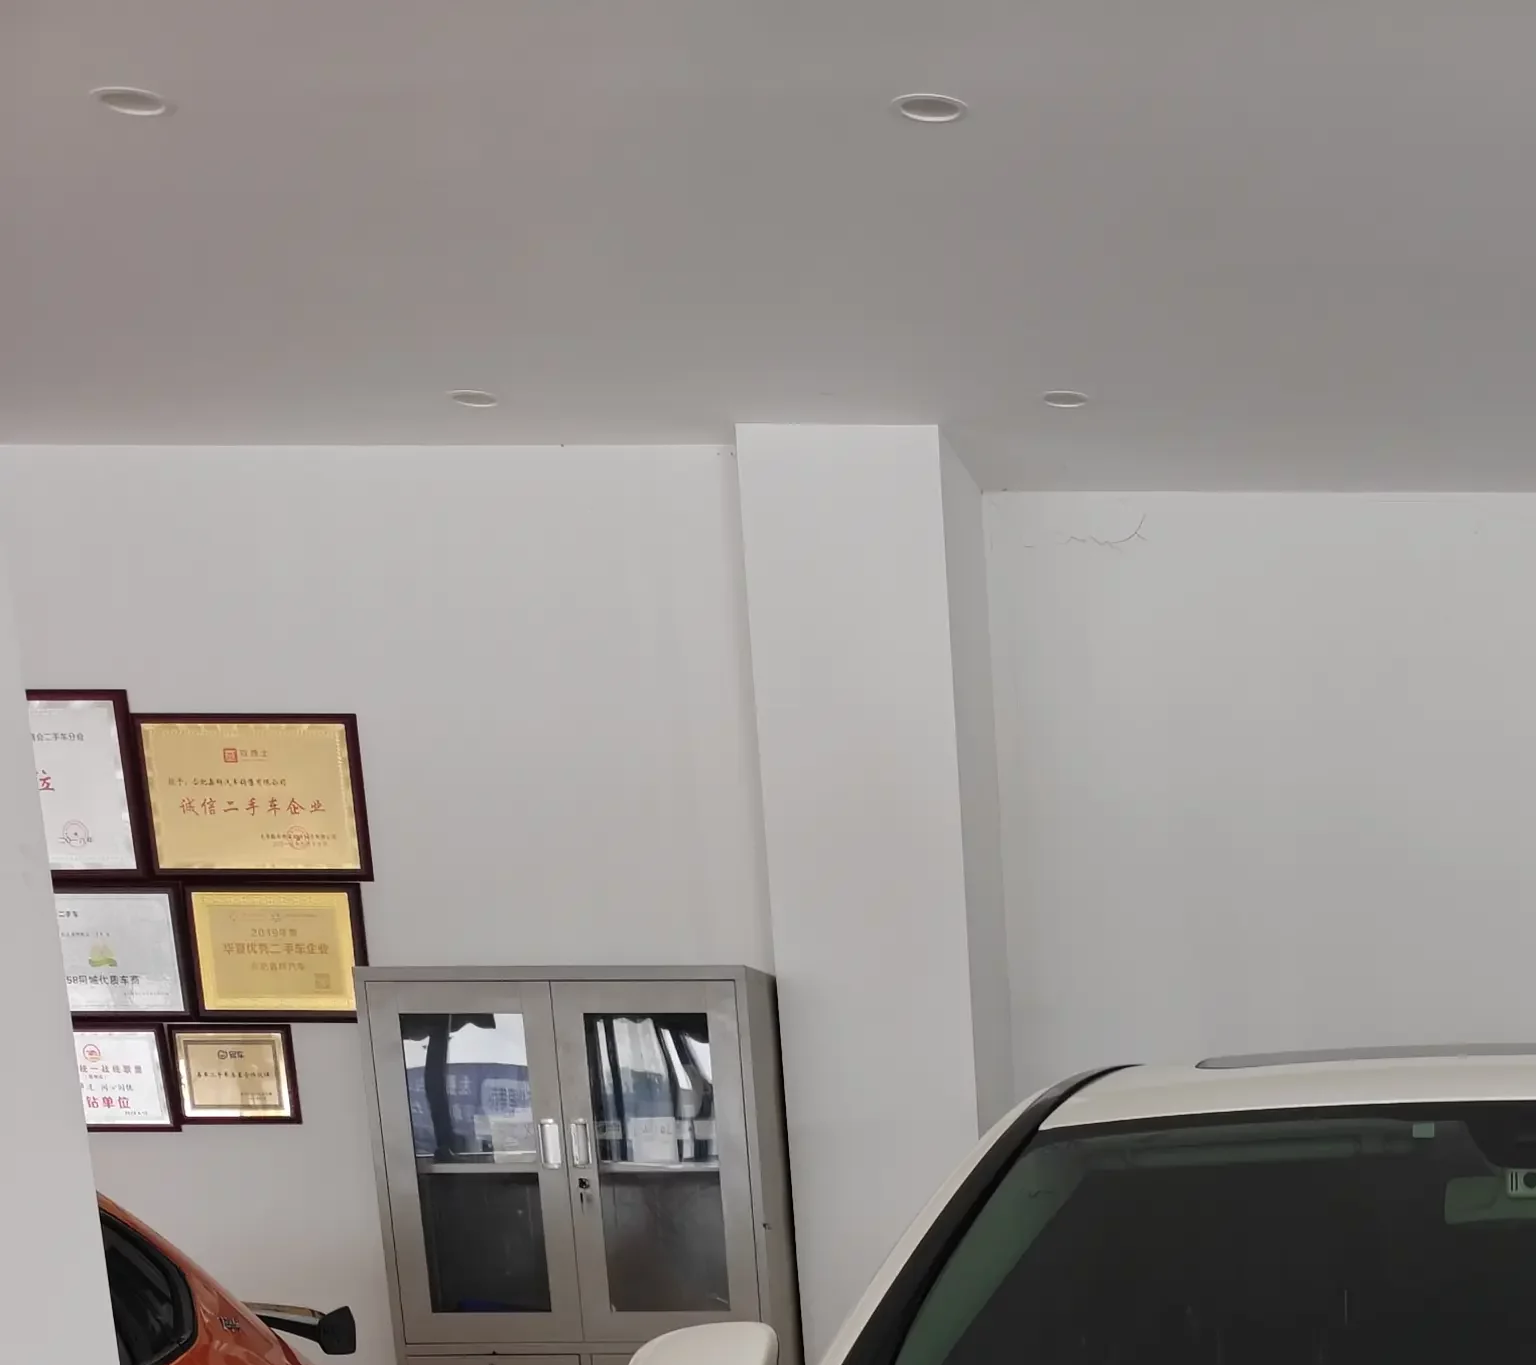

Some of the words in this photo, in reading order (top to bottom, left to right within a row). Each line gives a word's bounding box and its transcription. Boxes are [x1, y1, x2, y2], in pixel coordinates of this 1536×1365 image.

[180, 797, 326, 816] 诚信二手车企业
